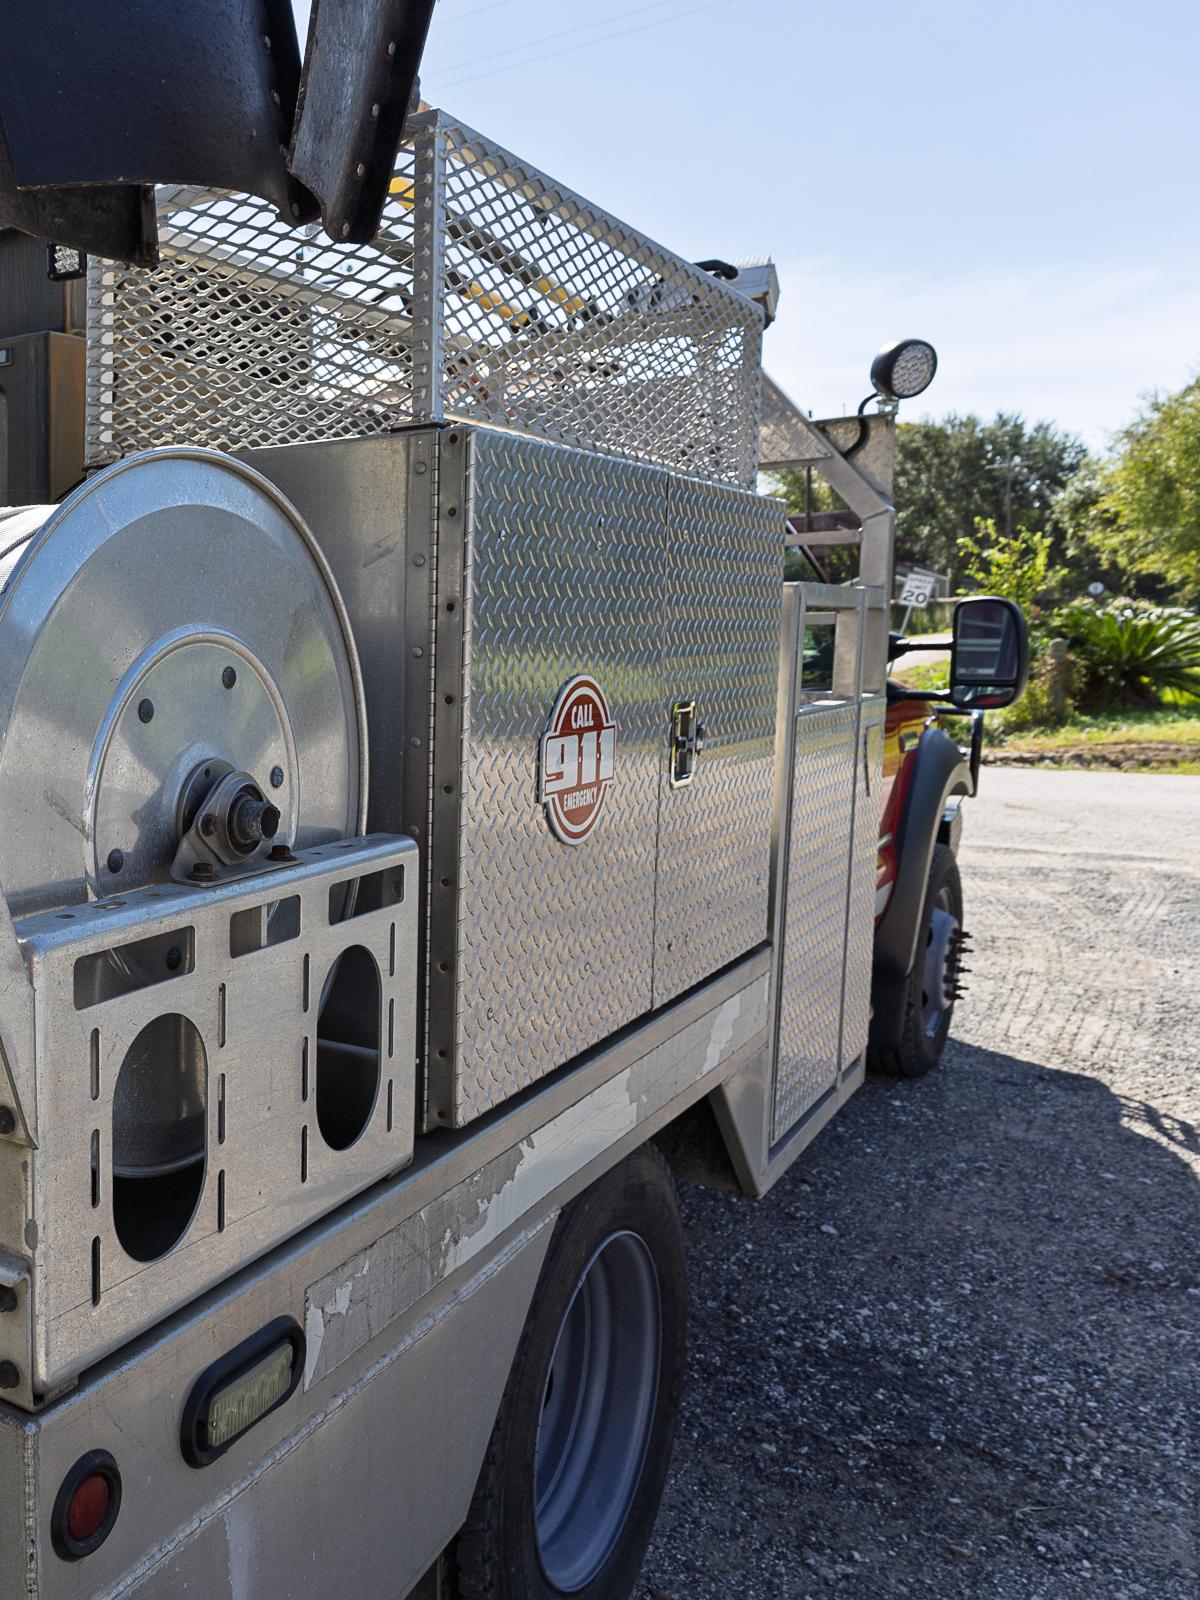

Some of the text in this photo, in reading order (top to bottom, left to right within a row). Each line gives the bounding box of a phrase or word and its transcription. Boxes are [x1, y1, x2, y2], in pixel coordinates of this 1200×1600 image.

[903, 590, 927, 604] 20
[571, 703, 594, 729] CALL
[563, 786, 598, 812] EMERGENCY
